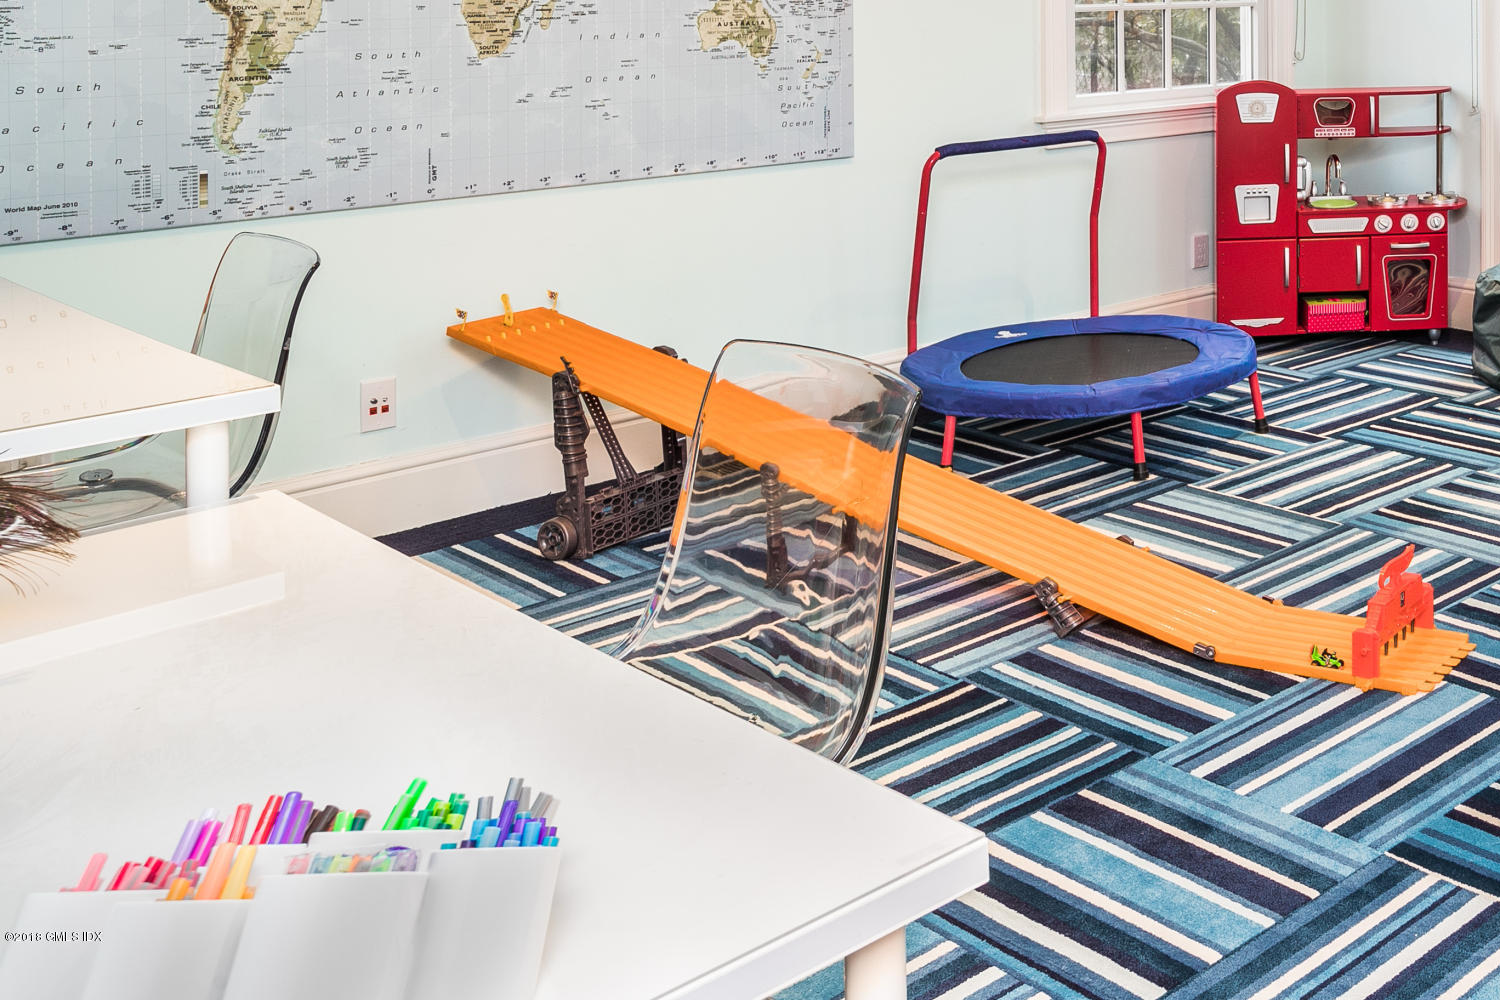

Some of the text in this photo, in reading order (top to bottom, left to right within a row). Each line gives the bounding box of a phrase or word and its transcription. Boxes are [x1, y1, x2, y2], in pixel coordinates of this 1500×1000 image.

[717, 20, 765, 28] AUSTRALIA
[578, 31, 661, 41] Indian
[353, 50, 422, 61] South
[228, 75, 273, 83] ARGENTINA
[584, 72, 657, 84] Ocean
[15, 83, 101, 95] South
[335, 86, 440, 99] Atlantic
[777, 83, 818, 93] South
[780, 101, 815, 111] Pacific
[0, 118, 144, 135] acific
[353, 123, 423, 135] Ocean
[781, 120, 815, 129] Ocean
[4, 205, 27, 214] World
[27, 205, 42, 213] Map
